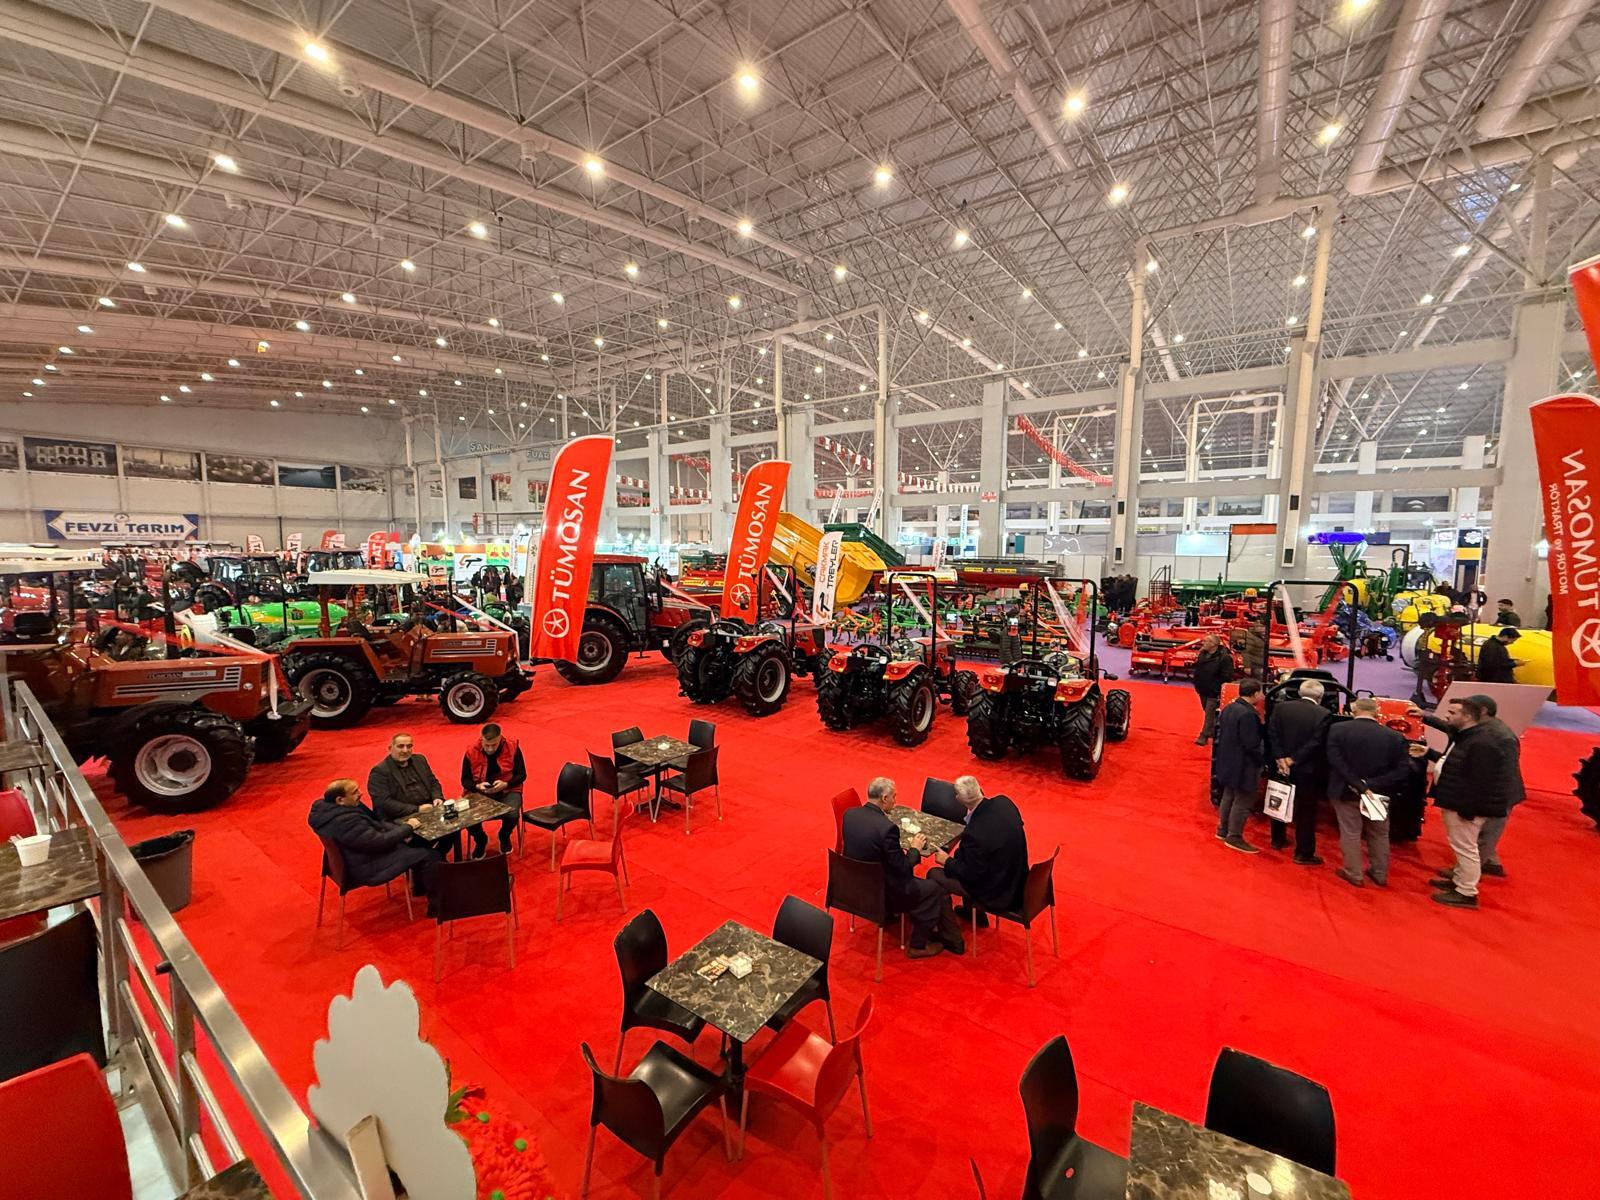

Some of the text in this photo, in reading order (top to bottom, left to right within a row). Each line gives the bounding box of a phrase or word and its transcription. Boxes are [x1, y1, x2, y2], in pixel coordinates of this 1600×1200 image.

[124, 522, 185, 535] TARIM
[549, 468, 590, 602] TÜMOSAN
[737, 482, 773, 580] TÜMOSAN
[827, 540, 839, 587] TREYLER
